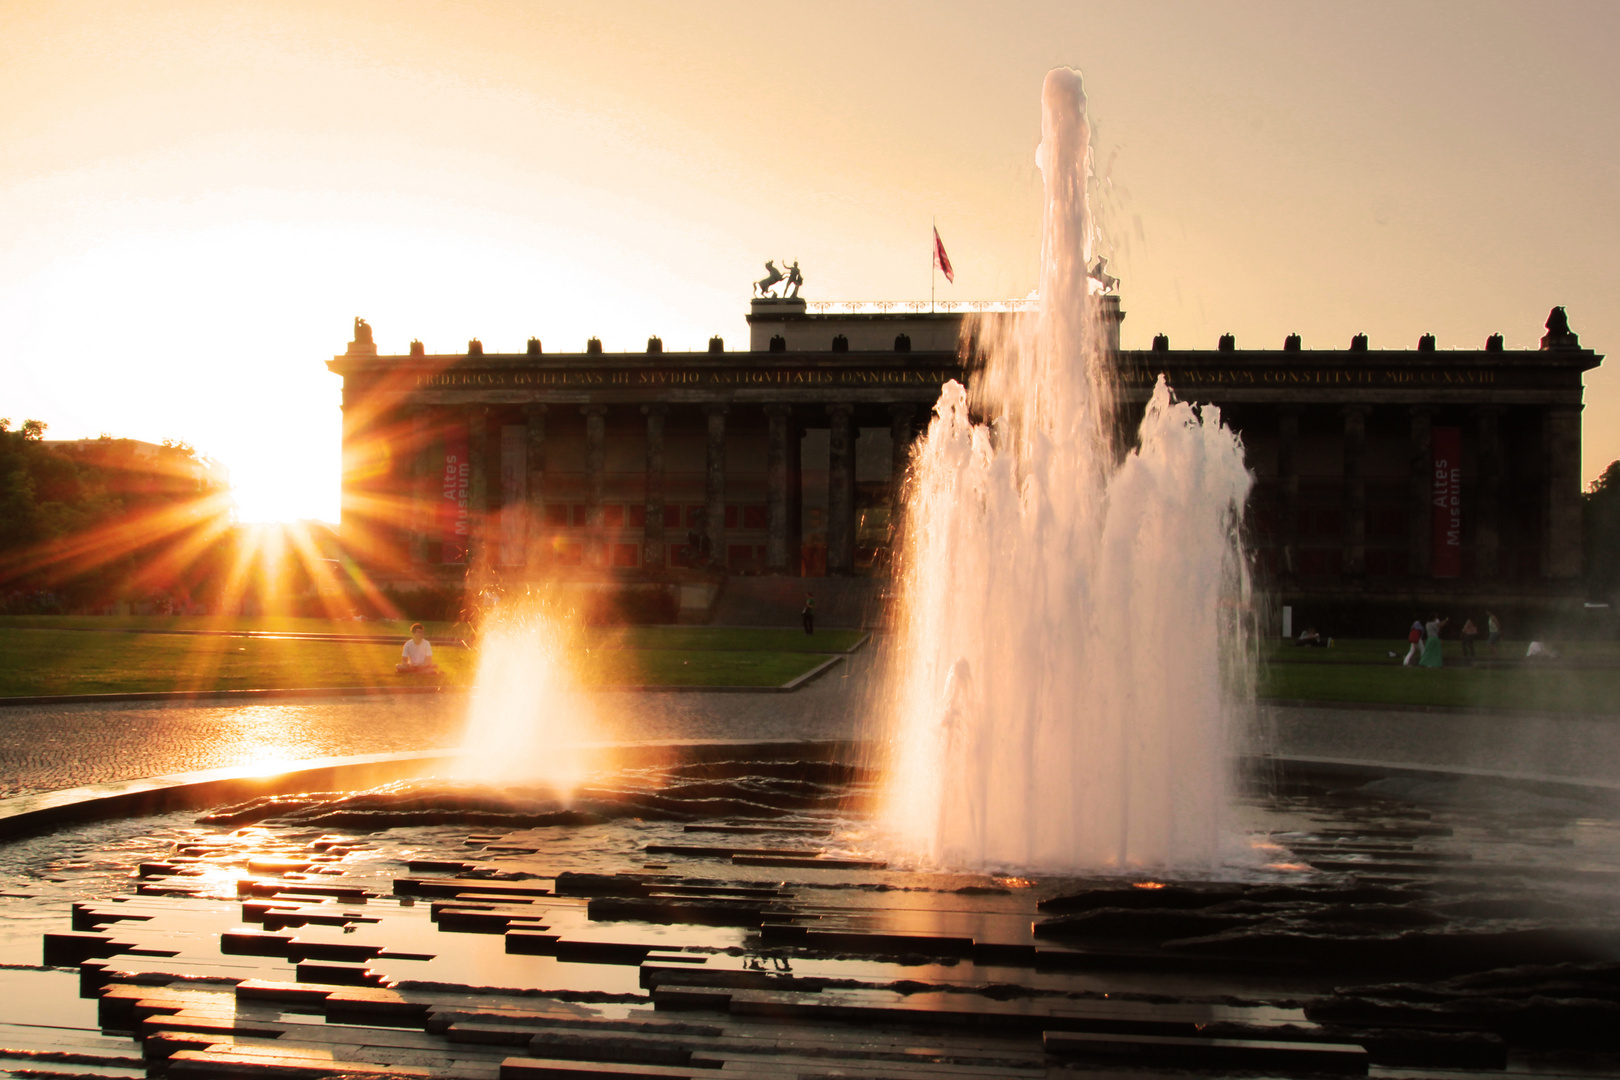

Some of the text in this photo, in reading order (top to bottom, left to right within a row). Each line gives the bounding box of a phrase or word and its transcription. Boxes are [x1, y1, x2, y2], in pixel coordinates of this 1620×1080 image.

[612, 372, 629, 384] III
[639, 371, 700, 384] STVDIO
[709, 371, 833, 383] ANTIQVITATIS
[1183, 370, 1255, 383] MVSEVM
[1263, 370, 1374, 383] CONSTITVIT
[444, 455, 457, 501] Altes
[455, 463, 469, 536] Museum
[1432, 459, 1448, 508] Altes
[1447, 468, 1460, 546] Museum
